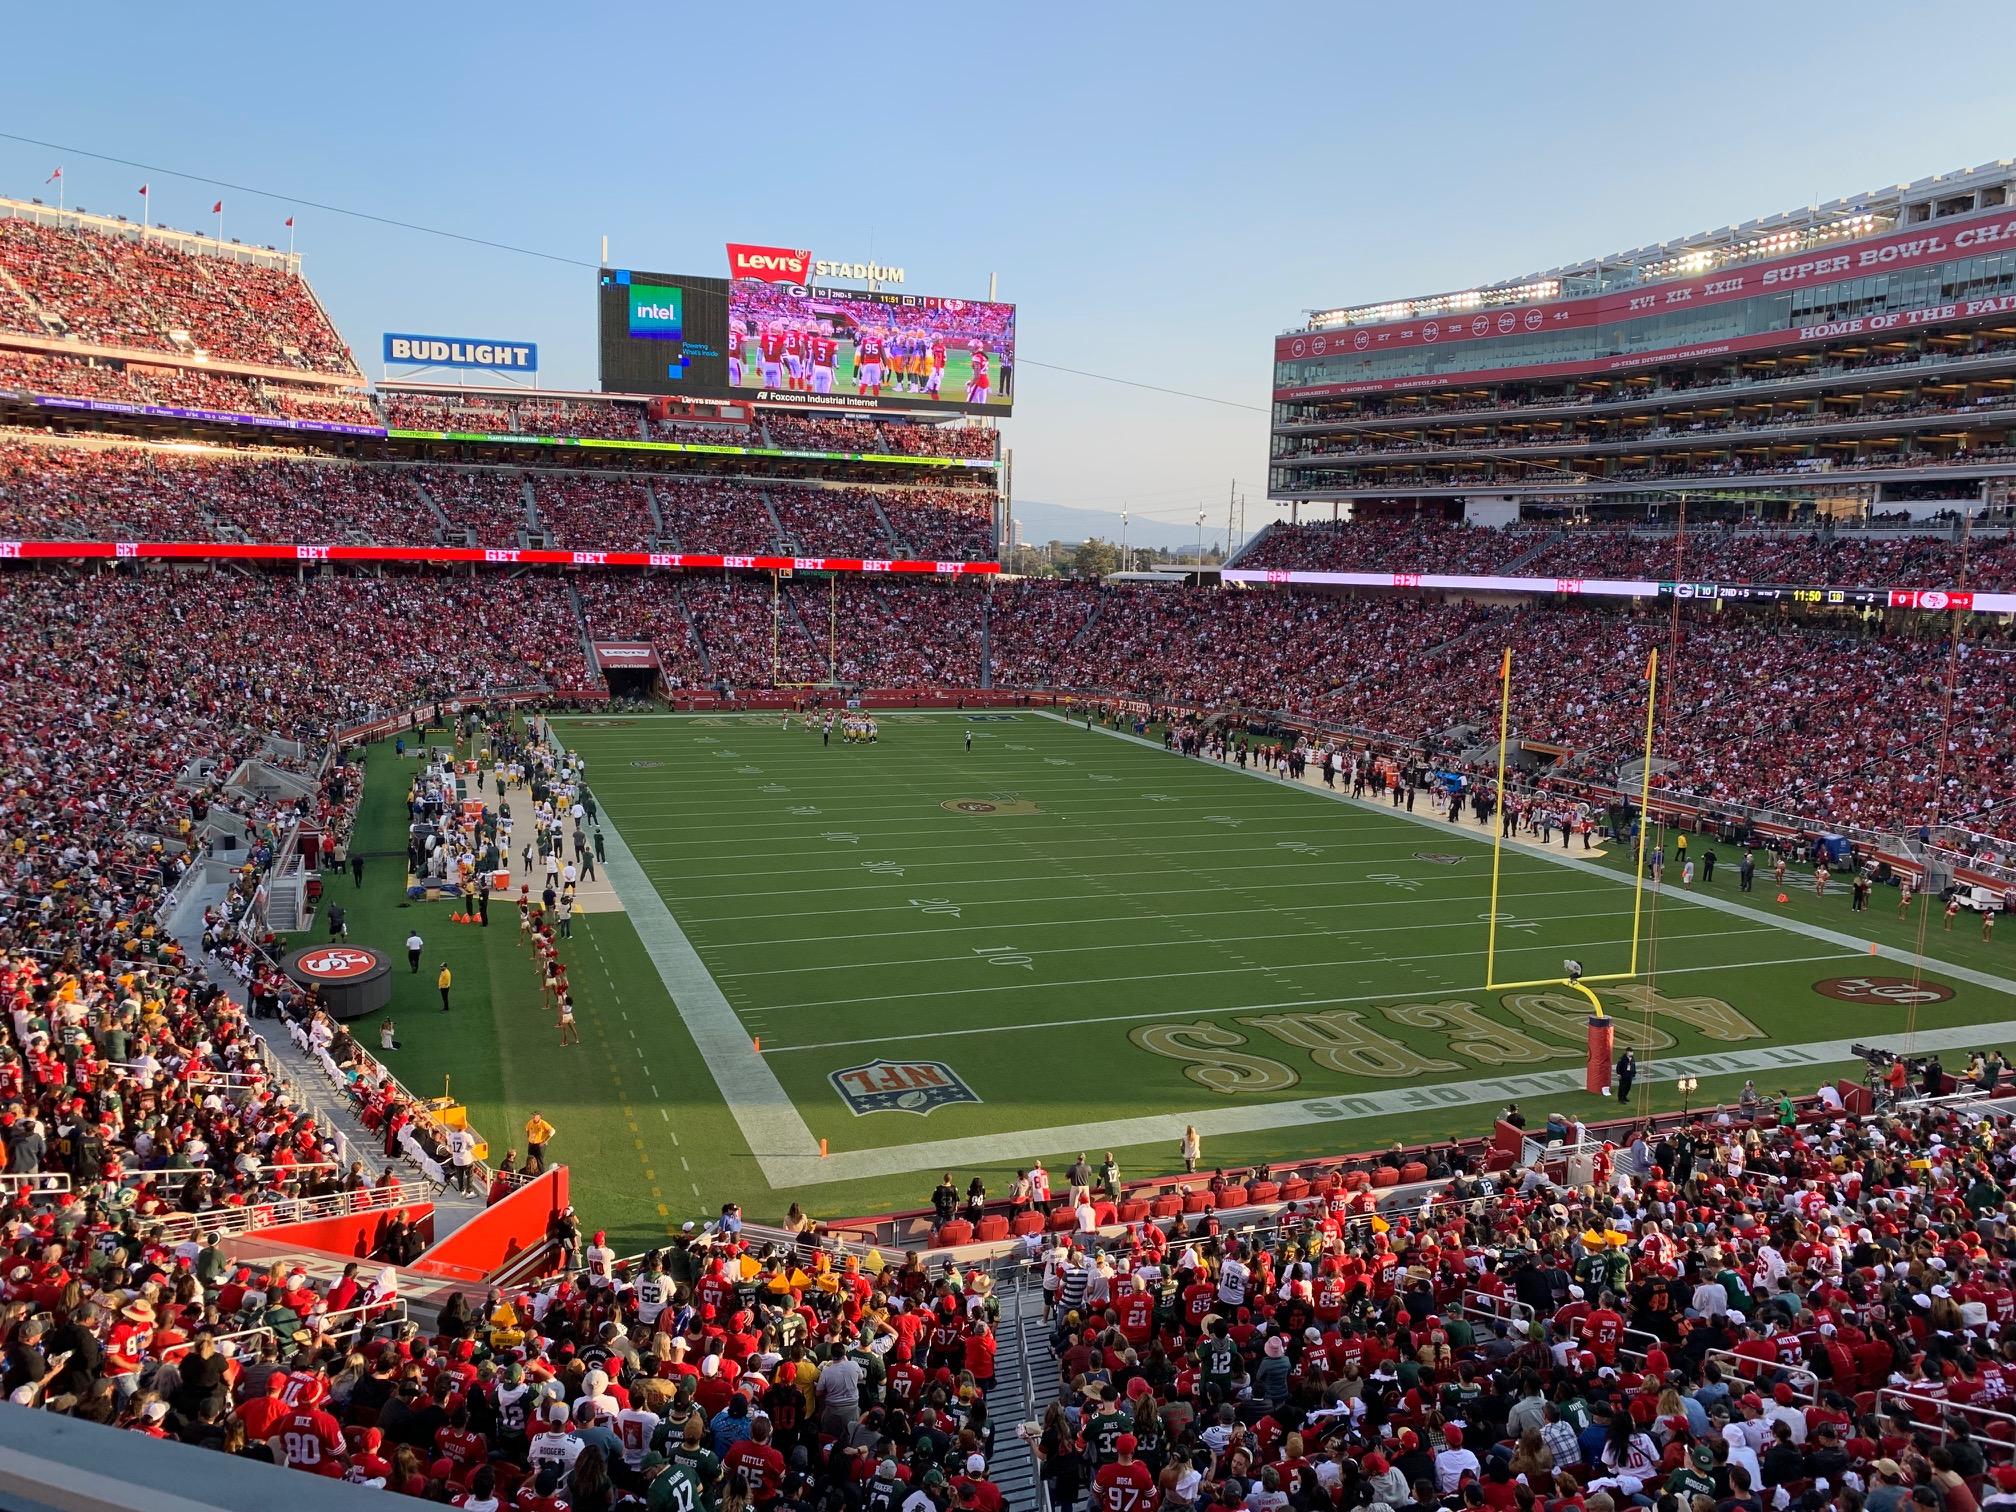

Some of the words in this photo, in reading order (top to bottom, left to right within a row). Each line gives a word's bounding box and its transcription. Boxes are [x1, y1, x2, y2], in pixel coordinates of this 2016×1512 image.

[1762, 253, 1851, 286] SUPER
[1858, 236, 1947, 267] BOWL
[816, 260, 905, 283] STADIUM
[1704, 278, 1744, 296] XXIII
[880, 295, 899, 304] 11:51
[1630, 295, 1656, 311] XVI
[1666, 288, 1692, 304] XIX
[638, 302, 673, 320] intel
[1552, 311, 1569, 320] 44
[1472, 320, 1488, 330] 37
[1498, 318, 1514, 327] 39
[1526, 314, 1542, 324] 42
[1800, 319, 1863, 340] HOME
[1870, 311, 1901, 329] OF
[1904, 304, 1956, 326] THE
[1400, 330, 1414, 339] 33
[1424, 327, 1438, 336] 34
[1448, 324, 1462, 332] 35
[1334, 338, 1345, 346] 14
[1356, 335, 1367, 344] 16
[1378, 333, 1391, 342] 27
[392, 339, 449, 361] BUD
[451, 344, 529, 366] LIGHT
[864, 343, 878, 355] 95
[1314, 341, 1324, 350] 12
[1642, 352, 1678, 366] DIVISION
[1679, 345, 1730, 359] CHAMPIONS
[1298, 390, 1330, 398] MORABITO
[1347, 384, 1383, 392] MORABITO
[770, 392, 806, 402] Foxconn
[807, 394, 844, 405] Industrial
[846, 397, 878, 407] Internet
[94, 402, 132, 412] RECEIVING
[255, 418, 286, 426] RECEIVING
[116, 544, 138, 557] GET
[296, 546, 330, 560] GET
[485, 550, 520, 562] GET
[572, 552, 606, 564] GET
[650, 554, 682, 566] GET
[723, 556, 755, 568] GET
[794, 558, 825, 570] GET
[862, 560, 892, 572] GET
[936, 562, 966, 573] GET
[1267, 570, 1293, 582] GET
[1393, 573, 1422, 587] GET
[1556, 578, 1584, 593] GET
[1702, 588, 1711, 596] 10
[1720, 588, 1737, 597] 2ND
[1744, 589, 1750, 597] 5
[1774, 590, 1780, 598] 7
[1793, 590, 1822, 602] 11:50
[1831, 593, 1841, 601] 19
[1867, 594, 1874, 602] 2
[1898, 595, 1906, 603] 0
[908, 897, 962, 914] 20
[972, 946, 1033, 966] 10
[1764, 1048, 1820, 1065] IT
[842, 1064, 948, 1094] NFL
[1480, 1072, 1583, 1096] ALL
[1400, 1088, 1472, 1107] OF
[1302, 1098, 1384, 1118] US
[452, 1142, 462, 1153] 17
[1034, 1176, 1048, 1188] 80
[1108, 1170, 1118, 1182] 17
[1481, 1182, 1494, 1195] 12
[588, 1260, 604, 1276] 10
[1590, 1266, 1604, 1284] 17
[1224, 1273, 1240, 1290] 12
[1382, 1269, 1396, 1282] 85
[706, 1280, 718, 1288] BOSA
[1736, 1280, 1750, 1296] 4
[642, 1286, 660, 1304] 52
[703, 1290, 722, 1307] 97
[1318, 1292, 1339, 1308] 85
[1128, 1310, 1146, 1326] 21
[937, 1329, 957, 1346] 97
[1172, 1336, 1182, 1346] 10
[1600, 1329, 1616, 1344] 54
[1345, 1348, 1361, 1358] KITTLE
[1210, 1352, 1230, 1374] 12
[893, 1379, 912, 1398] 97
[1568, 1401, 1584, 1412] FAVRE
[294, 1416, 311, 1427] RICE
[502, 1406, 524, 1430] 12
[774, 1406, 796, 1430] 10
[1578, 1410, 1589, 1428] 4
[1103, 1422, 1118, 1432] JONES
[284, 1432, 320, 1464] 80
[444, 1442, 466, 1454] WILLIS
[1137, 1432, 1158, 1451] 33
[540, 1446, 566, 1457] RODGERS
[742, 1454, 764, 1467] KITTLE
[1628, 1452, 1644, 1468] 10
[668, 1470, 684, 1486] ADAMS
[737, 1466, 763, 1489] 85
[1116, 1476, 1132, 1486] BOSA
[873, 1481, 894, 1493] RODGERS
[1686, 1476, 1710, 1494] RODGERS
[673, 1480, 694, 1512] 17
[1108, 1488, 1138, 1512] 97
